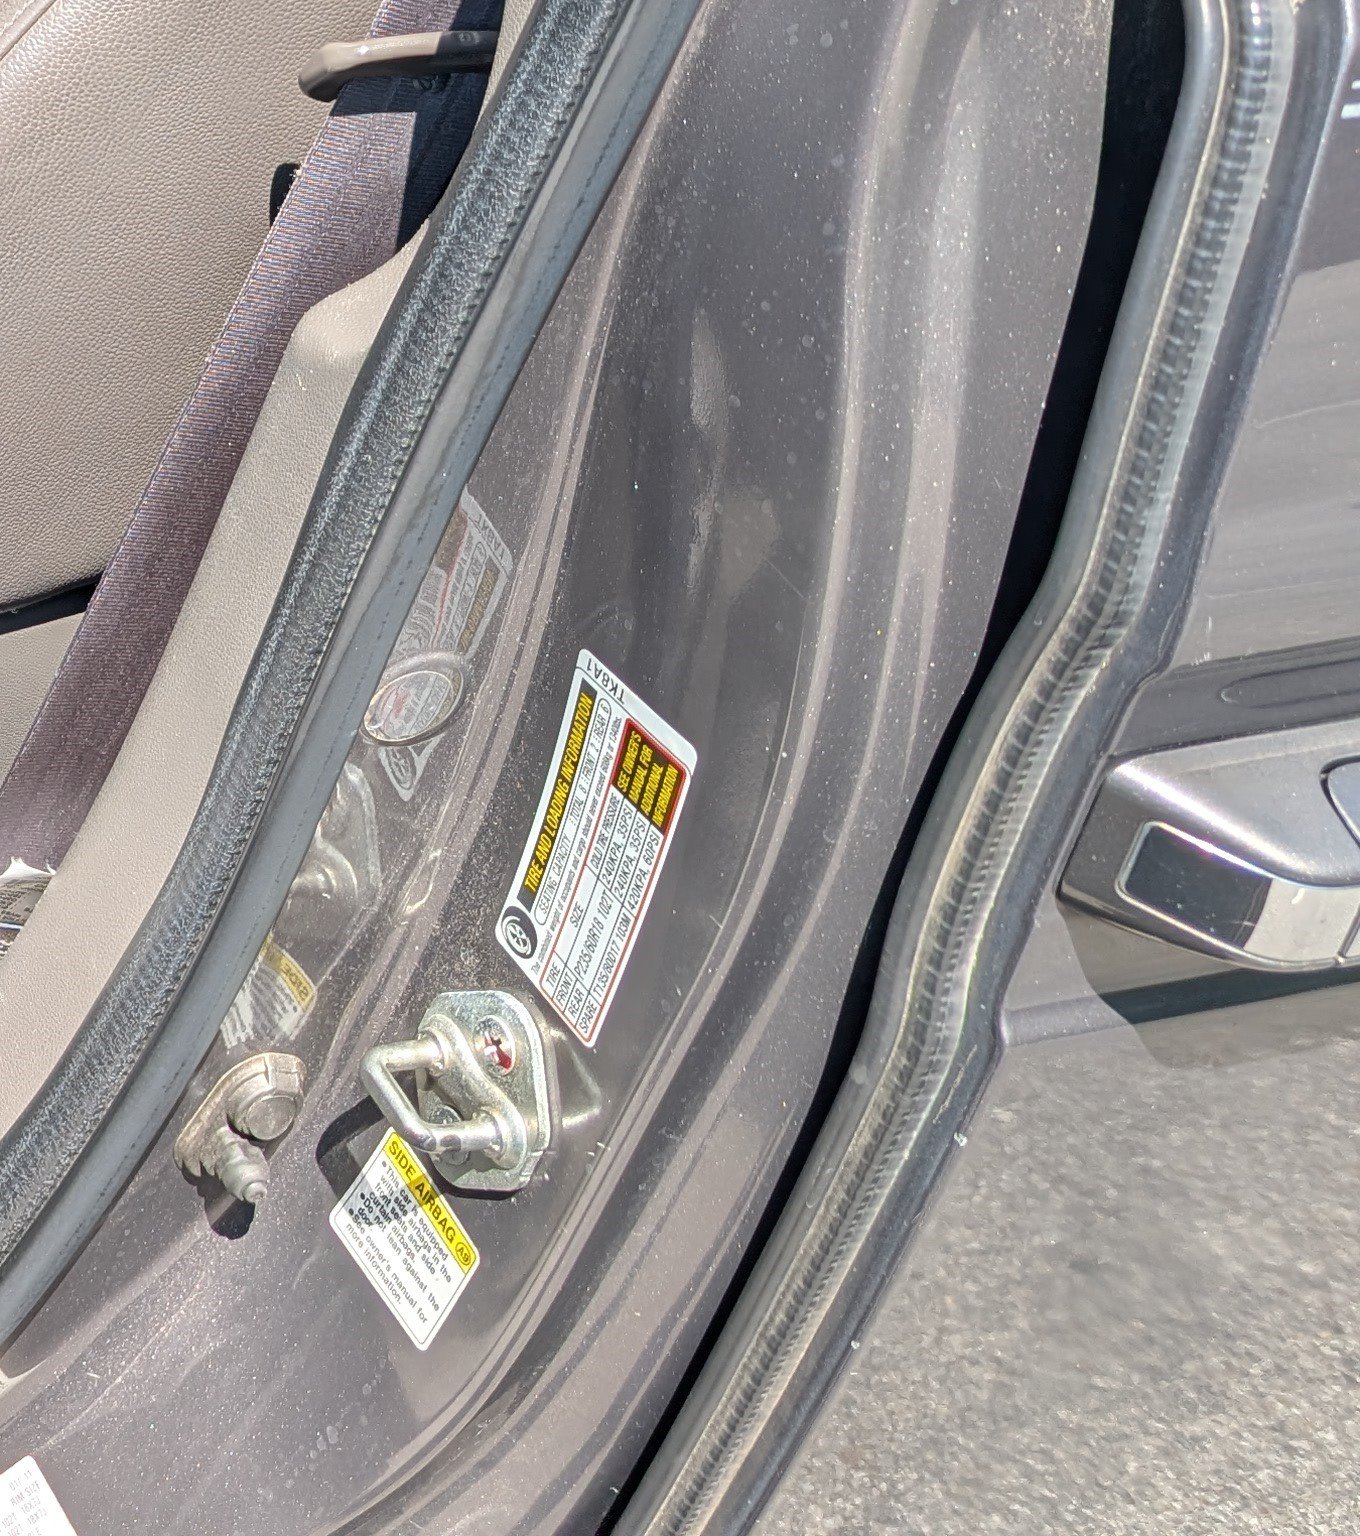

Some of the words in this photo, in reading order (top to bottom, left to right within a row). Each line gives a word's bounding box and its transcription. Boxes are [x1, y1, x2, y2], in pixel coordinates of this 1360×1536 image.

[584, 656, 628, 705] TK8A1
[616, 769, 630, 793] SEE
[621, 729, 642, 776] OWNER'S
[628, 762, 647, 804] MANUAL
[639, 742, 653, 768] FOR
[524, 857, 543, 895] TIRE
[534, 831, 552, 866] AND
[543, 776, 569, 838] LOADING
[560, 690, 592, 783] INFORMATION
[601, 791, 620, 834] PRESSURE
[639, 759, 663, 816] ADDITIONAL
[651, 763, 678, 828] INFORMATION
[589, 844, 603, 871] COLD
[595, 829, 608, 850] TIRE
[601, 835, 624, 885] 240KPA,
[616, 802, 633, 839] 35PSI
[613, 848, 637, 899] 240KPA,
[628, 815, 646, 853] 35PSI
[538, 874, 557, 915] SEATING
[551, 832, 571, 878] CAPACITY
[626, 862, 650, 913] 420KPA,
[641, 829, 660, 867] 60PSI
[569, 900, 584, 929] SIZE
[573, 915, 604, 980] P235/60R18
[596, 888, 614, 920] 102T
[545, 960, 561, 990] TIRE
[592, 939, 620, 999] T135/80D17
[614, 911, 631, 943] 103M
[555, 970, 573, 1007] FRONT
[567, 986, 584, 1019] REAR
[578, 998, 597, 1034] SPARE
[367, 1189, 393, 1225] curtain
[384, 1165, 401, 1189] This
[398, 1187, 412, 1207] car
[410, 1204, 419, 1217] is
[417, 1216, 449, 1263] equipped
[387, 1138, 416, 1181] SIDE
[414, 1178, 457, 1244] AIRBAG
[345, 1221, 364, 1249] more
[362, 1196, 374, 1214] Do
[373, 1213, 386, 1233] not
[385, 1231, 402, 1256] lean
[400, 1254, 427, 1293] against
[427, 1291, 440, 1312] the
[374, 1181, 391, 1207] front
[389, 1204, 409, 1233] seats
[407, 1230, 422, 1253] and
[420, 1251, 437, 1276] side
[379, 1173, 395, 1197] with
[393, 1194, 409, 1218] side
[407, 1216, 433, 1255] airbags
[431, 1252, 440, 1265] in
[439, 1263, 452, 1283] the
[351, 1212, 367, 1235] See
[390, 1270, 417, 1309] manual
[415, 1306, 428, 1324] for
